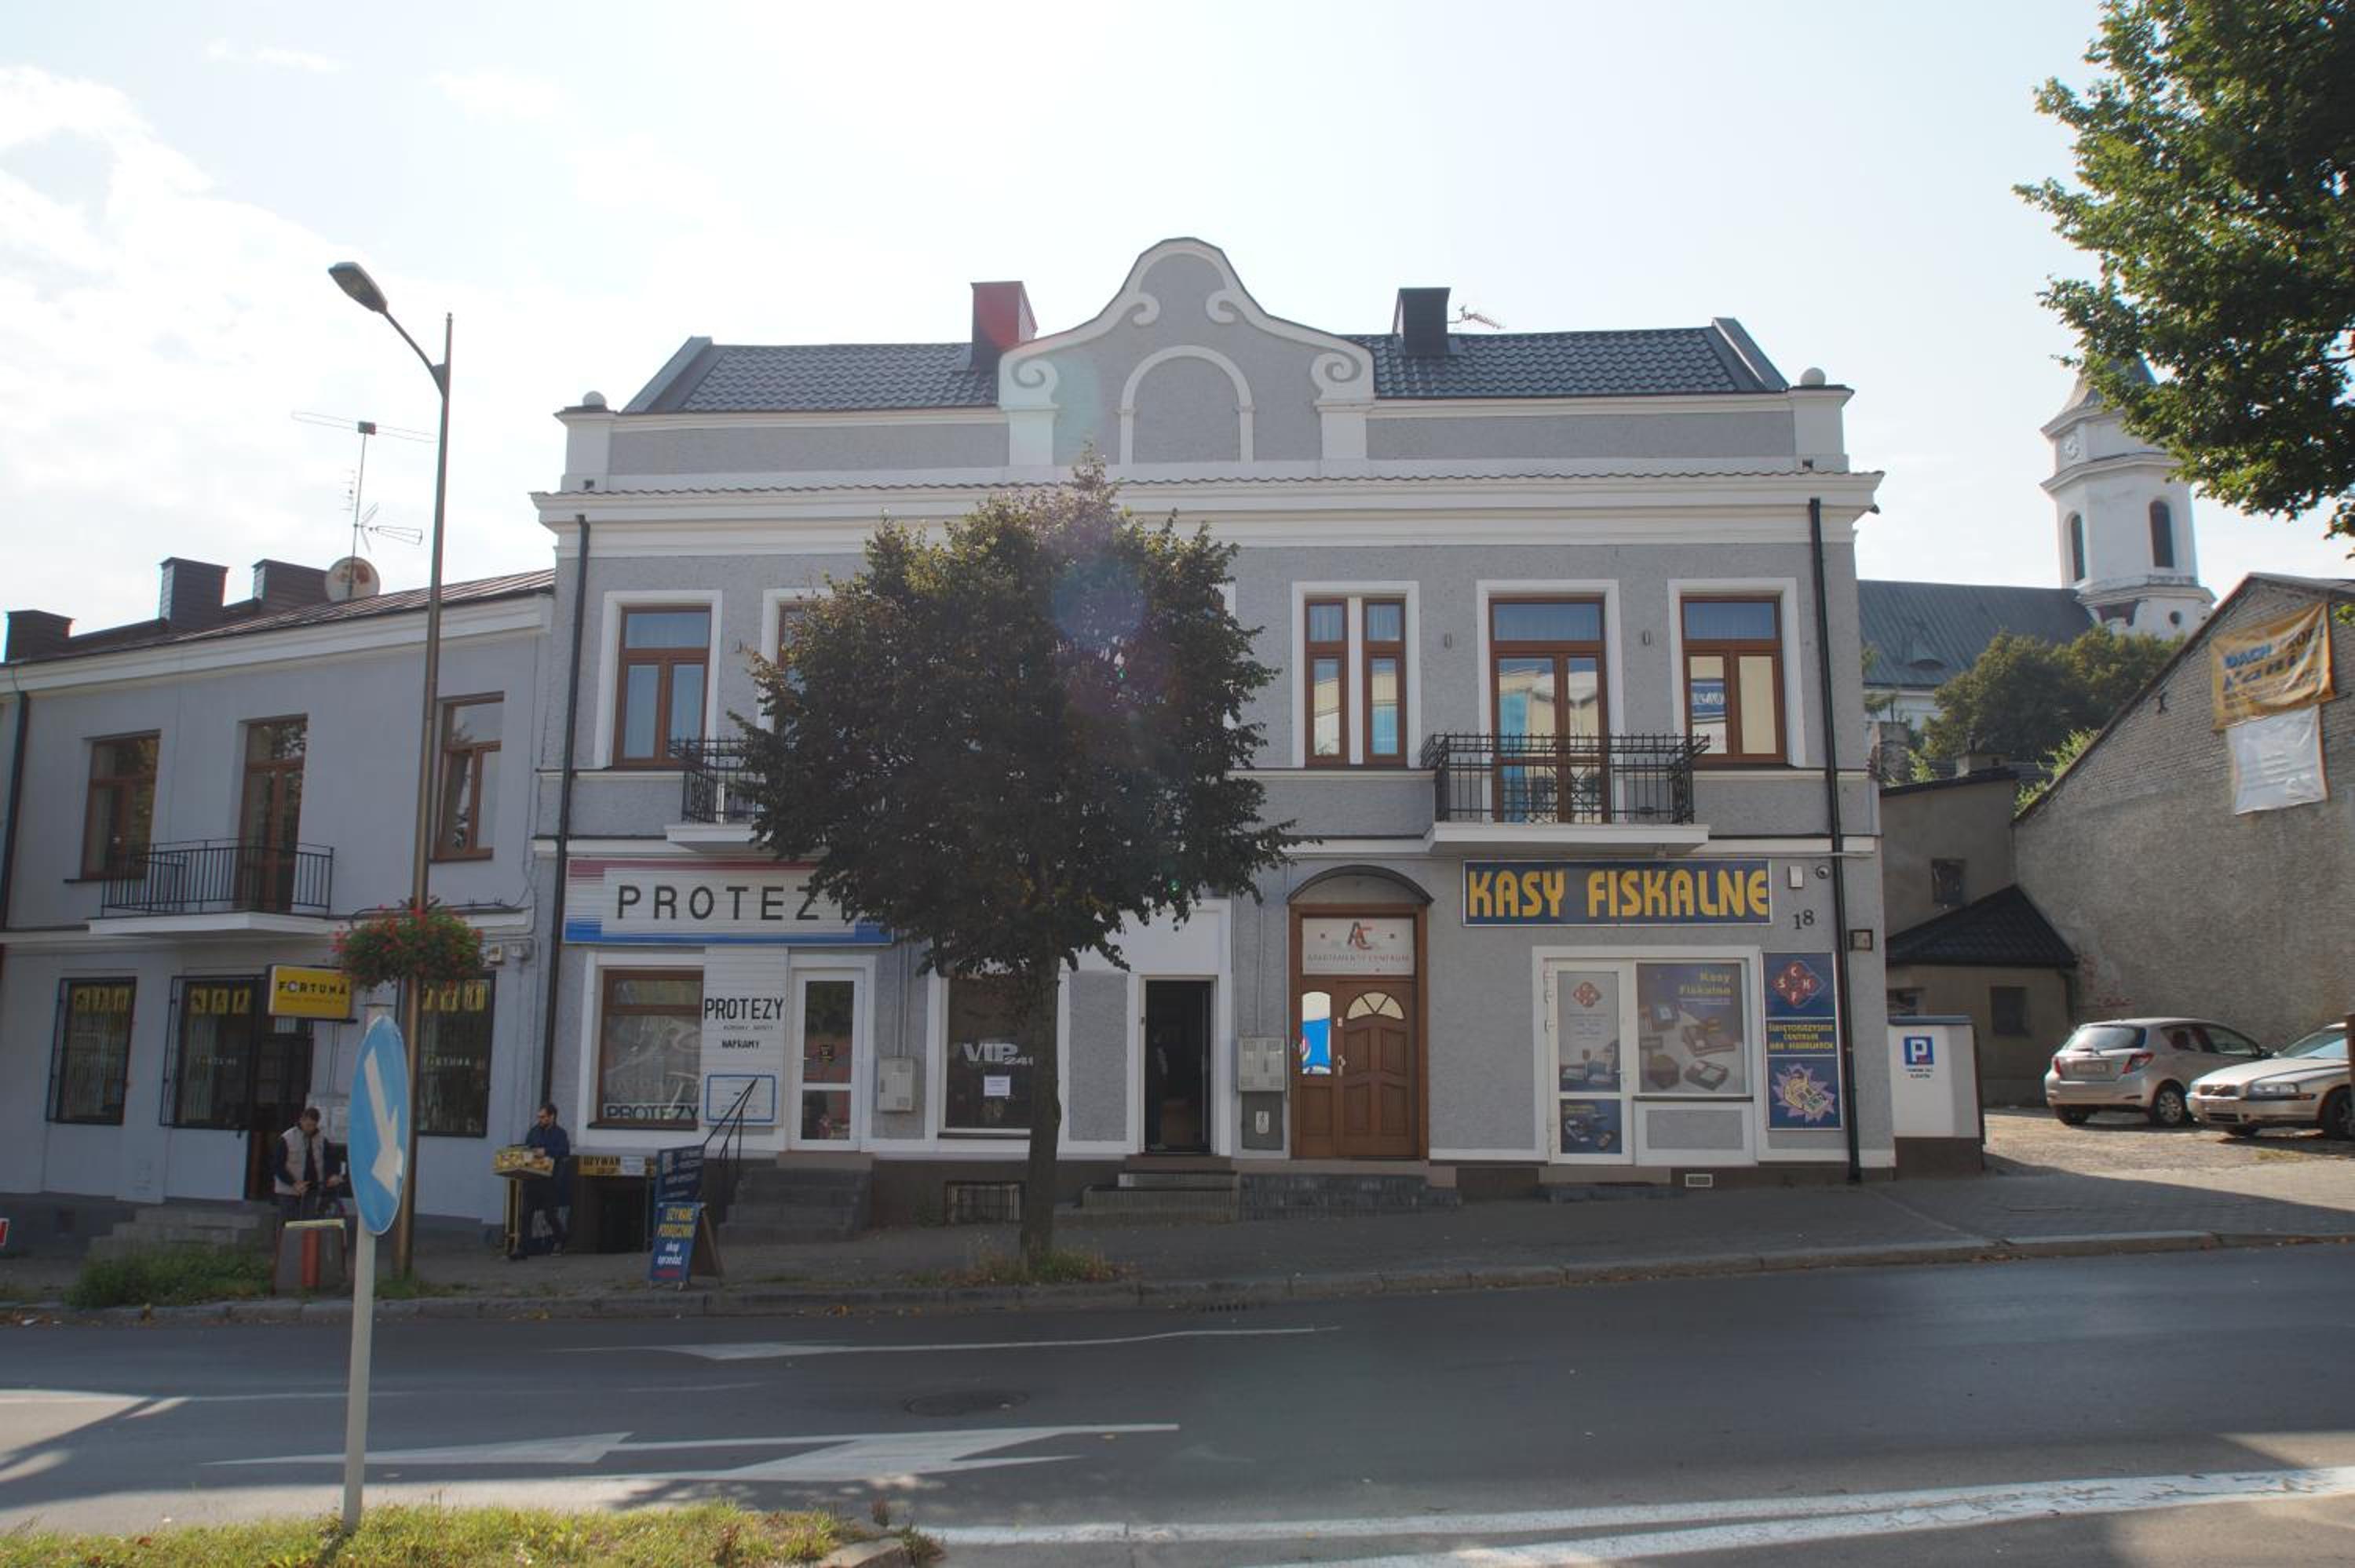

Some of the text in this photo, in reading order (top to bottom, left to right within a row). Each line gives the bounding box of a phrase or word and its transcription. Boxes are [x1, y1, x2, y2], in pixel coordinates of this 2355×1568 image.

[1468, 869, 1769, 917] KASY FISKALNE
[1793, 909, 1815, 929] 18
[278, 981, 346, 994] FORTUNA
[704, 997, 783, 1020] PROTEZY
[963, 1043, 1018, 1062] VIP
[607, 1104, 699, 1118] PROTEZY
